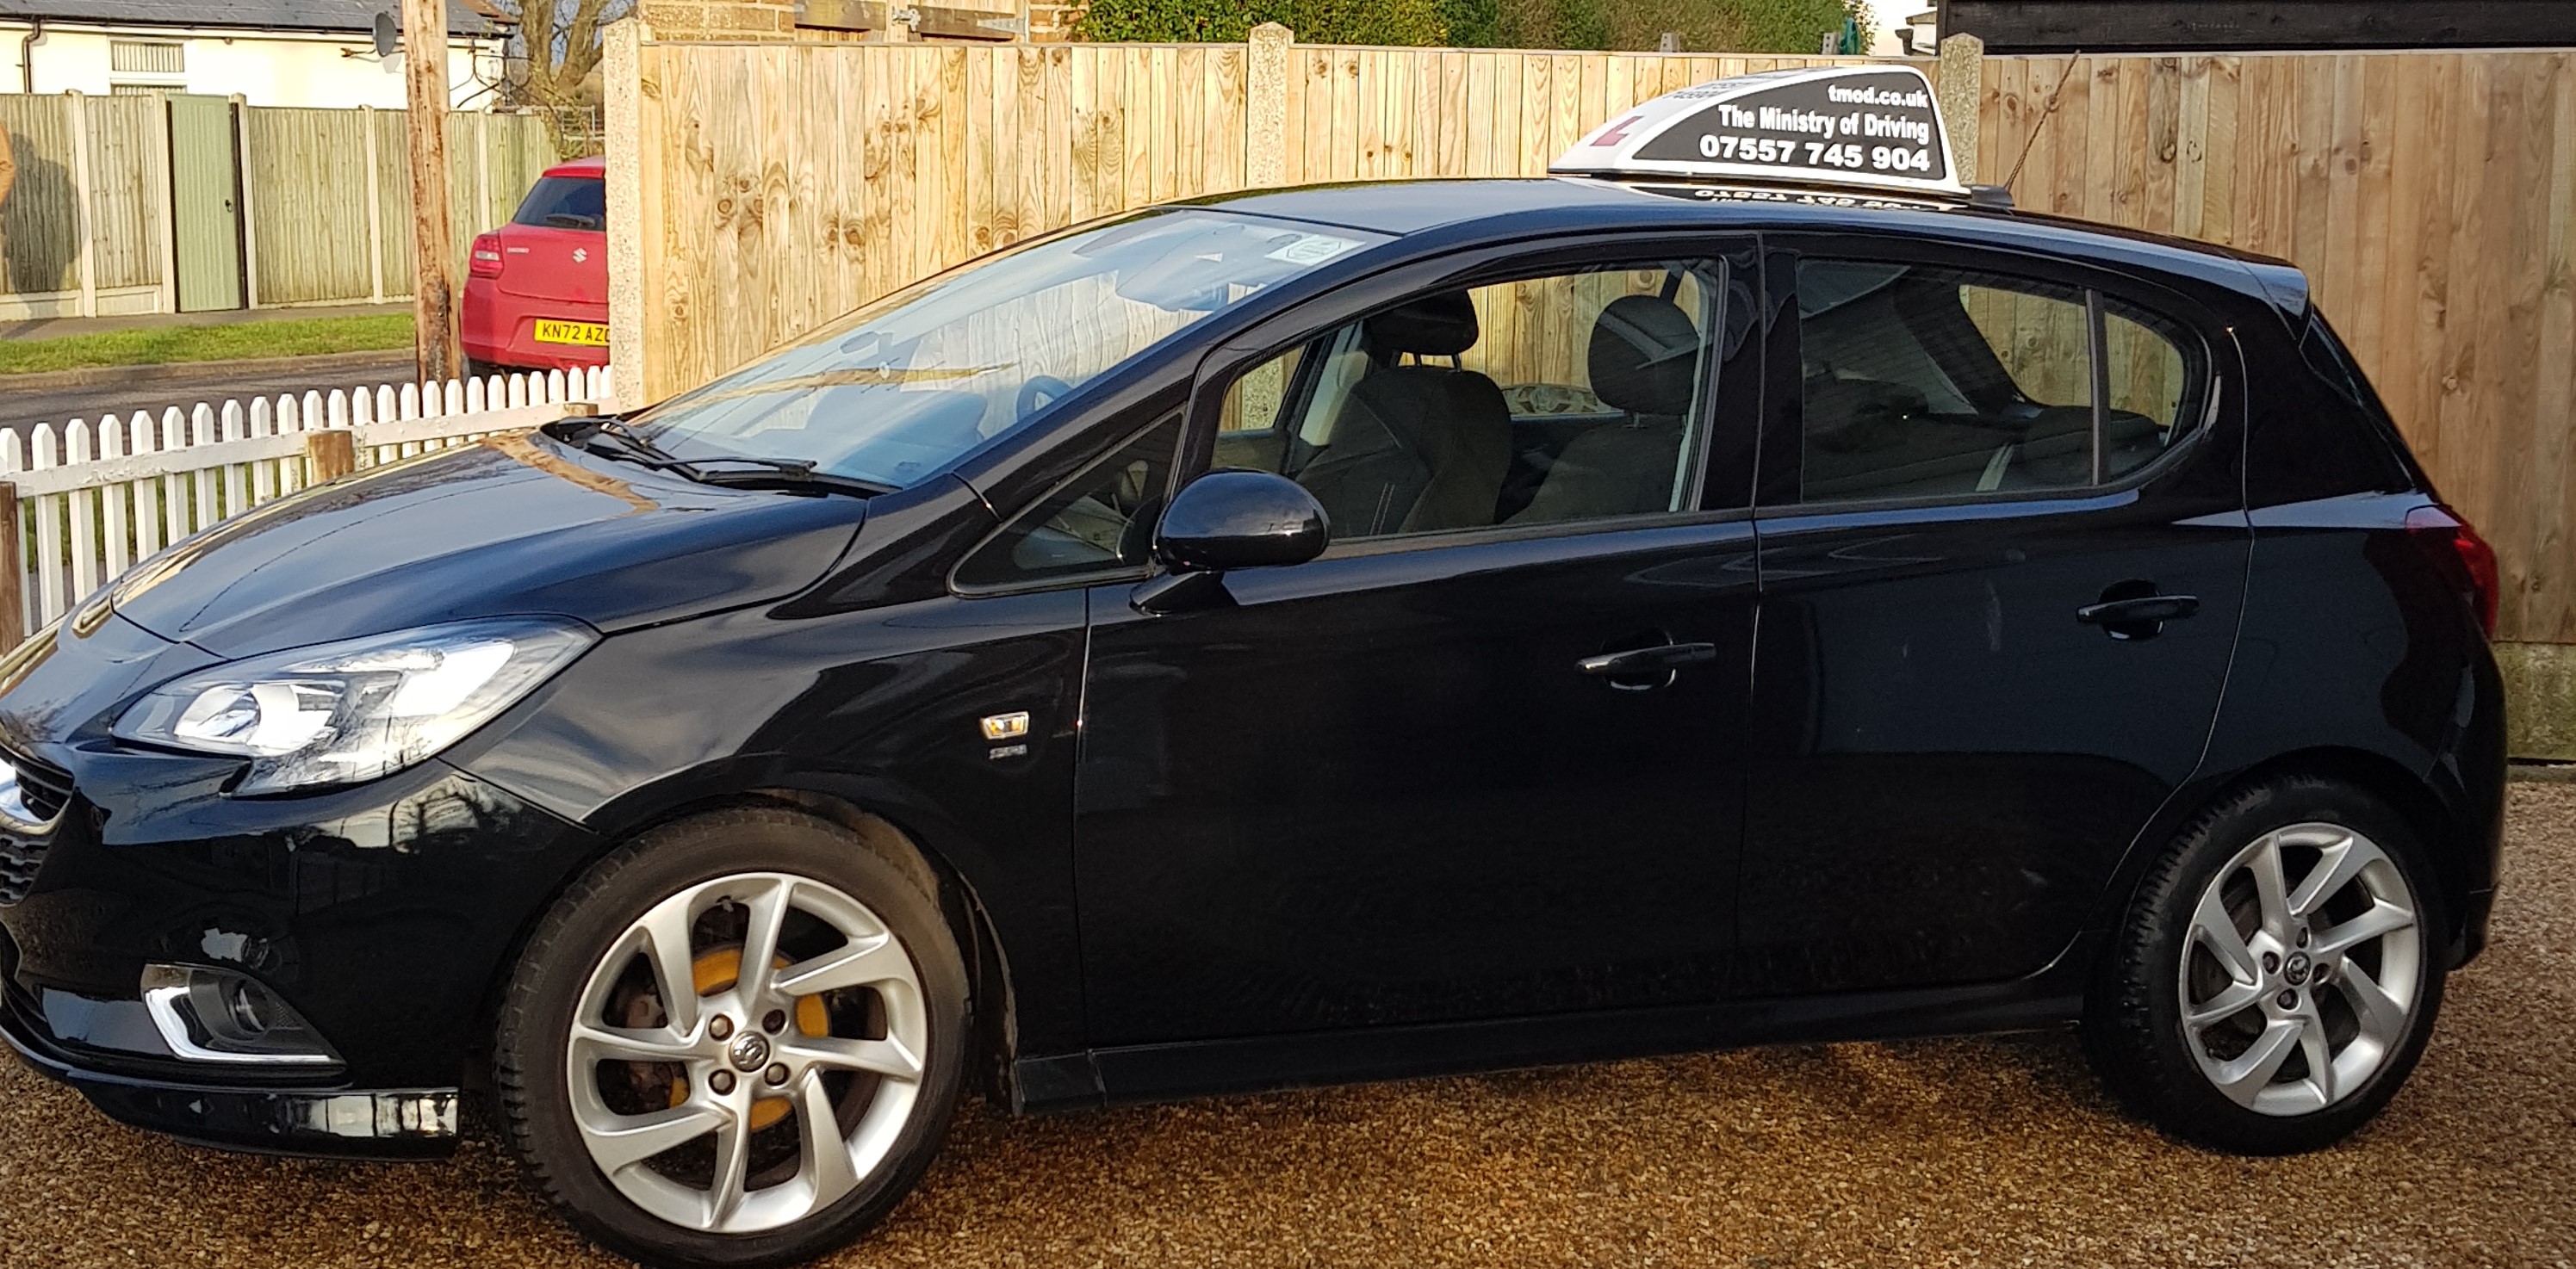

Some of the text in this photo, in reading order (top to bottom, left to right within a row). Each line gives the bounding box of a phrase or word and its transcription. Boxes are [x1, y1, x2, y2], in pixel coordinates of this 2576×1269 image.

[1828, 84, 1929, 108] tmod.co.uk
[1718, 103, 1929, 145] The Ministry of Driving
[1699, 134, 1930, 171] 07557 745 904
[542, 323, 581, 341] KN72
